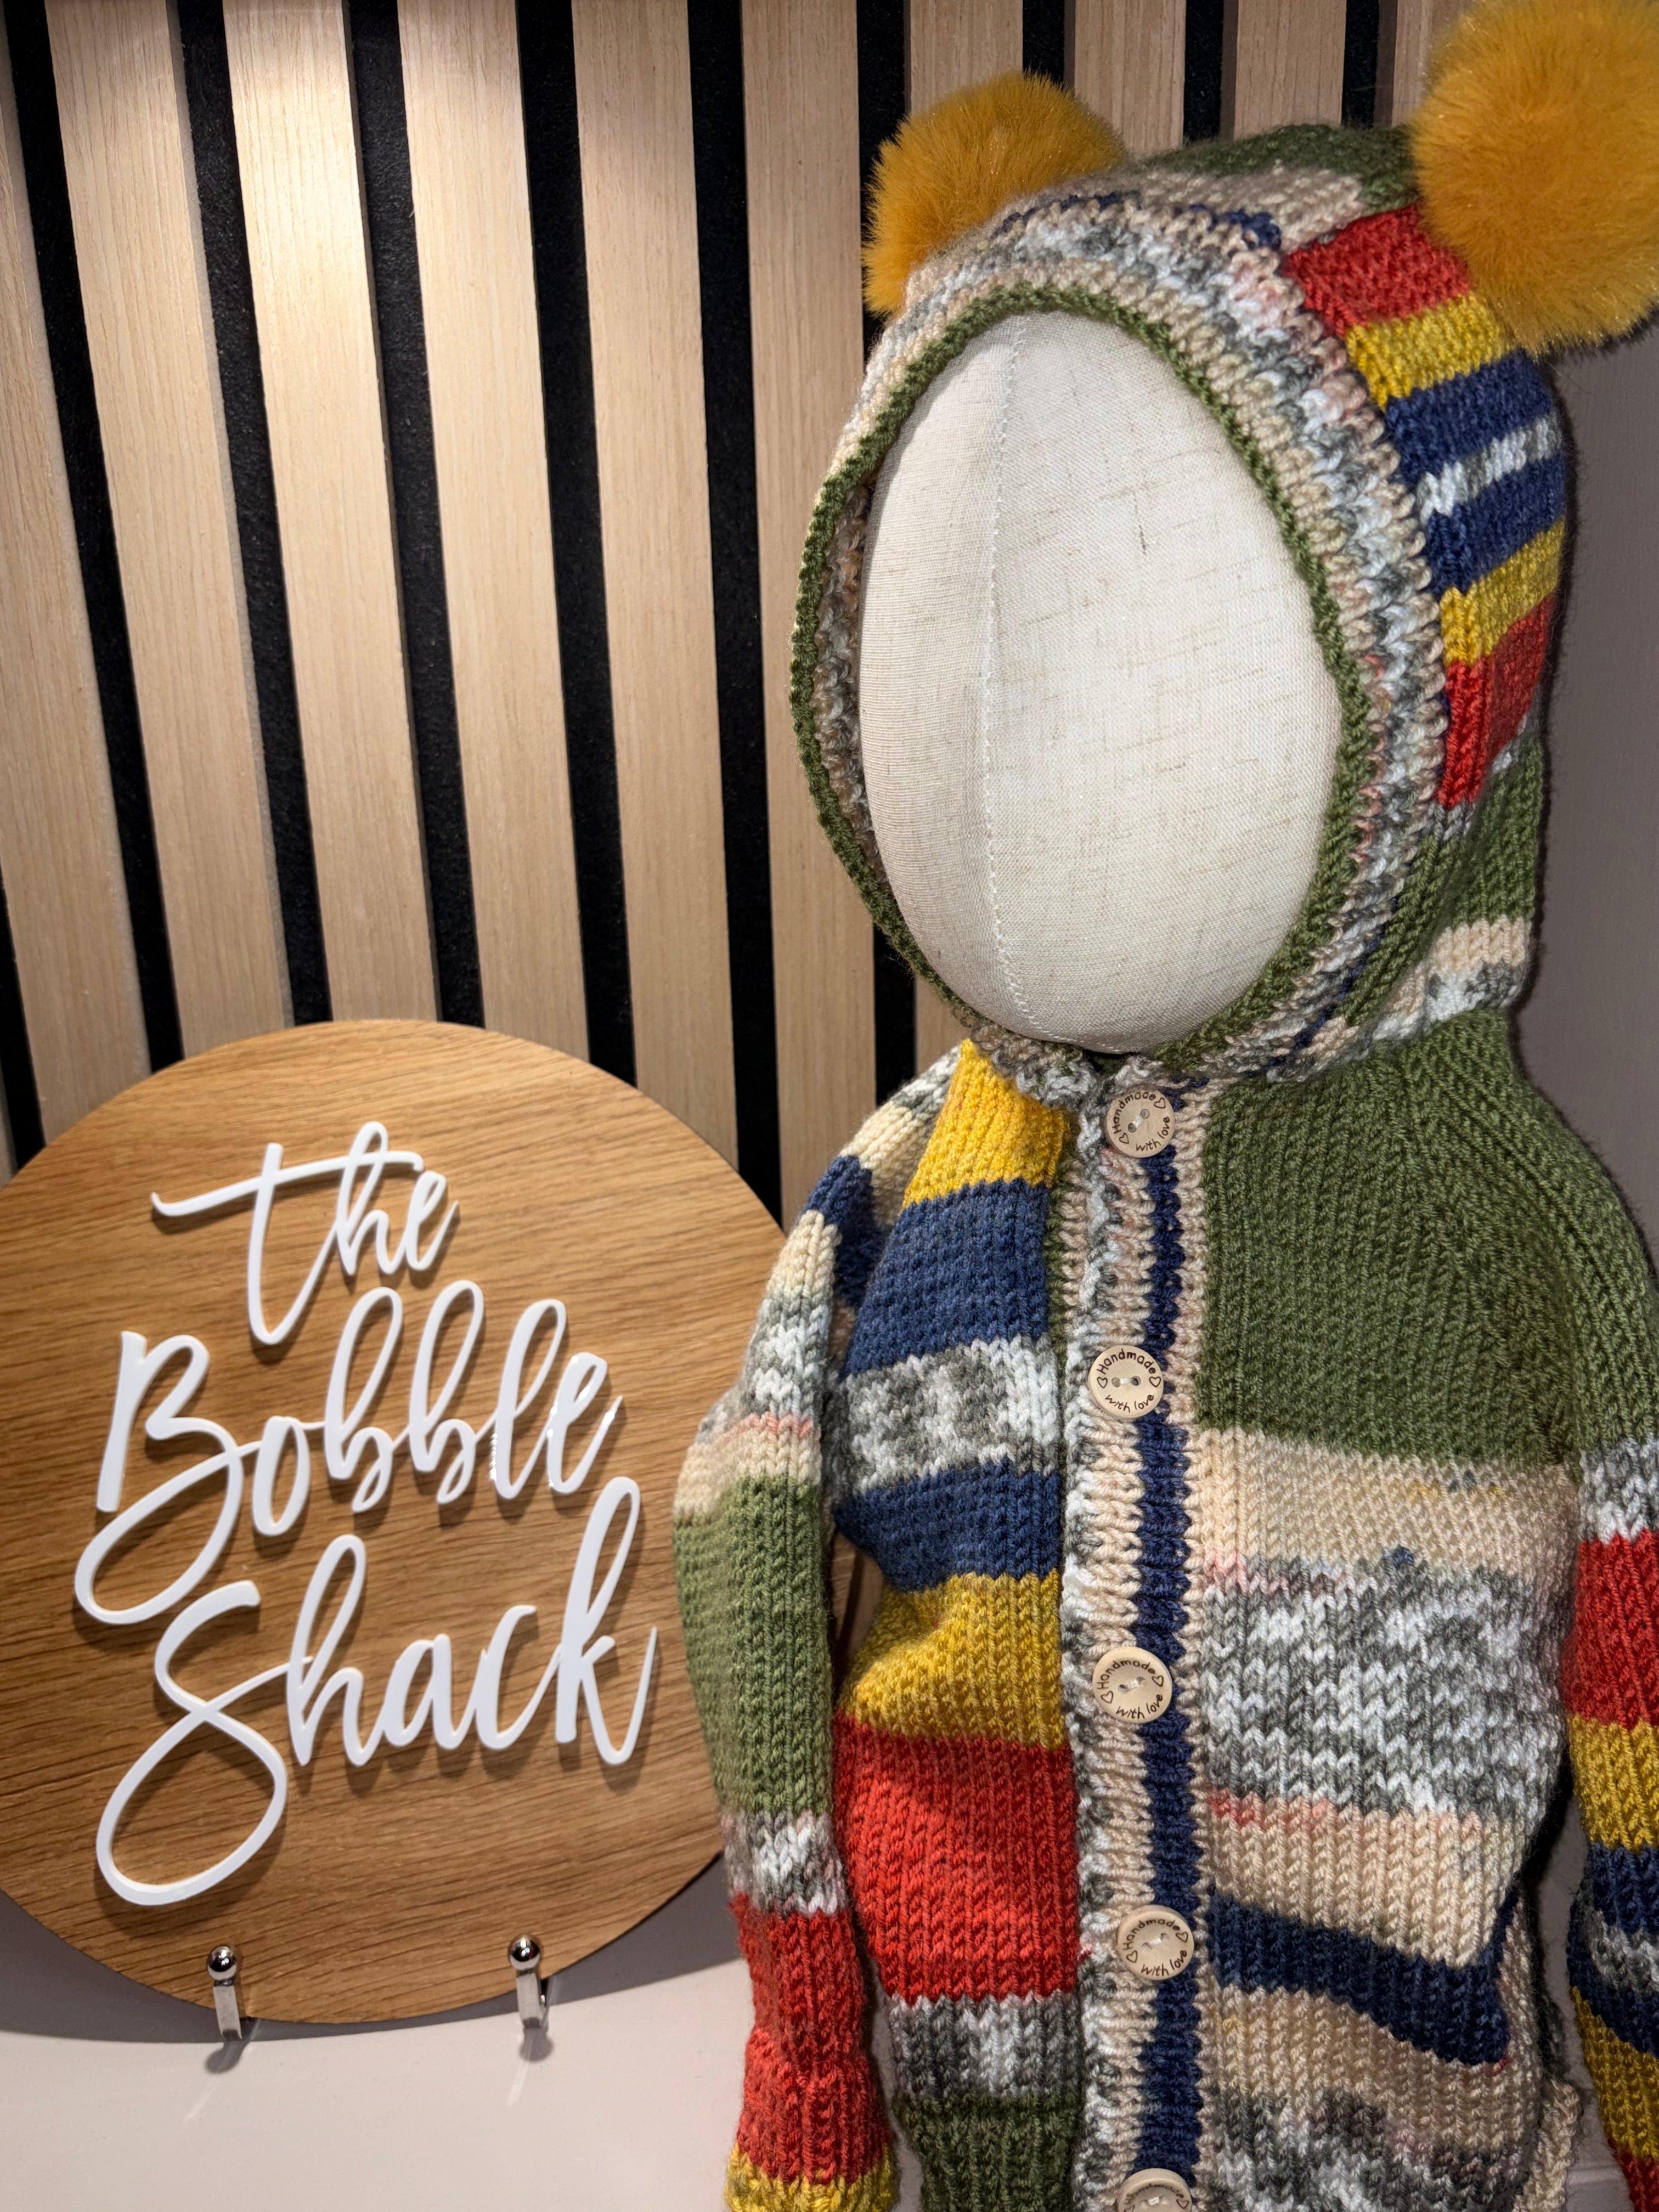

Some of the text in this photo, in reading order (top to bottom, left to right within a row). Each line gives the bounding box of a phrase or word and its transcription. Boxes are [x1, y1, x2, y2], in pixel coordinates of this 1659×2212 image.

[1112, 1092, 1156, 1134] Handmade
[1136, 1116, 1170, 1152] with love
[1097, 1348, 1156, 1375] Handmade
[1105, 1394, 1154, 1413] with love
[74, 1280, 623, 1624] Bobble
[1097, 1660, 1155, 1690] Handmade
[96, 1477, 658, 1906] Shack
[1115, 1694, 1163, 1719] with love
[1122, 1919, 1180, 1950] Handmade
[1141, 1950, 1187, 1976] with love
